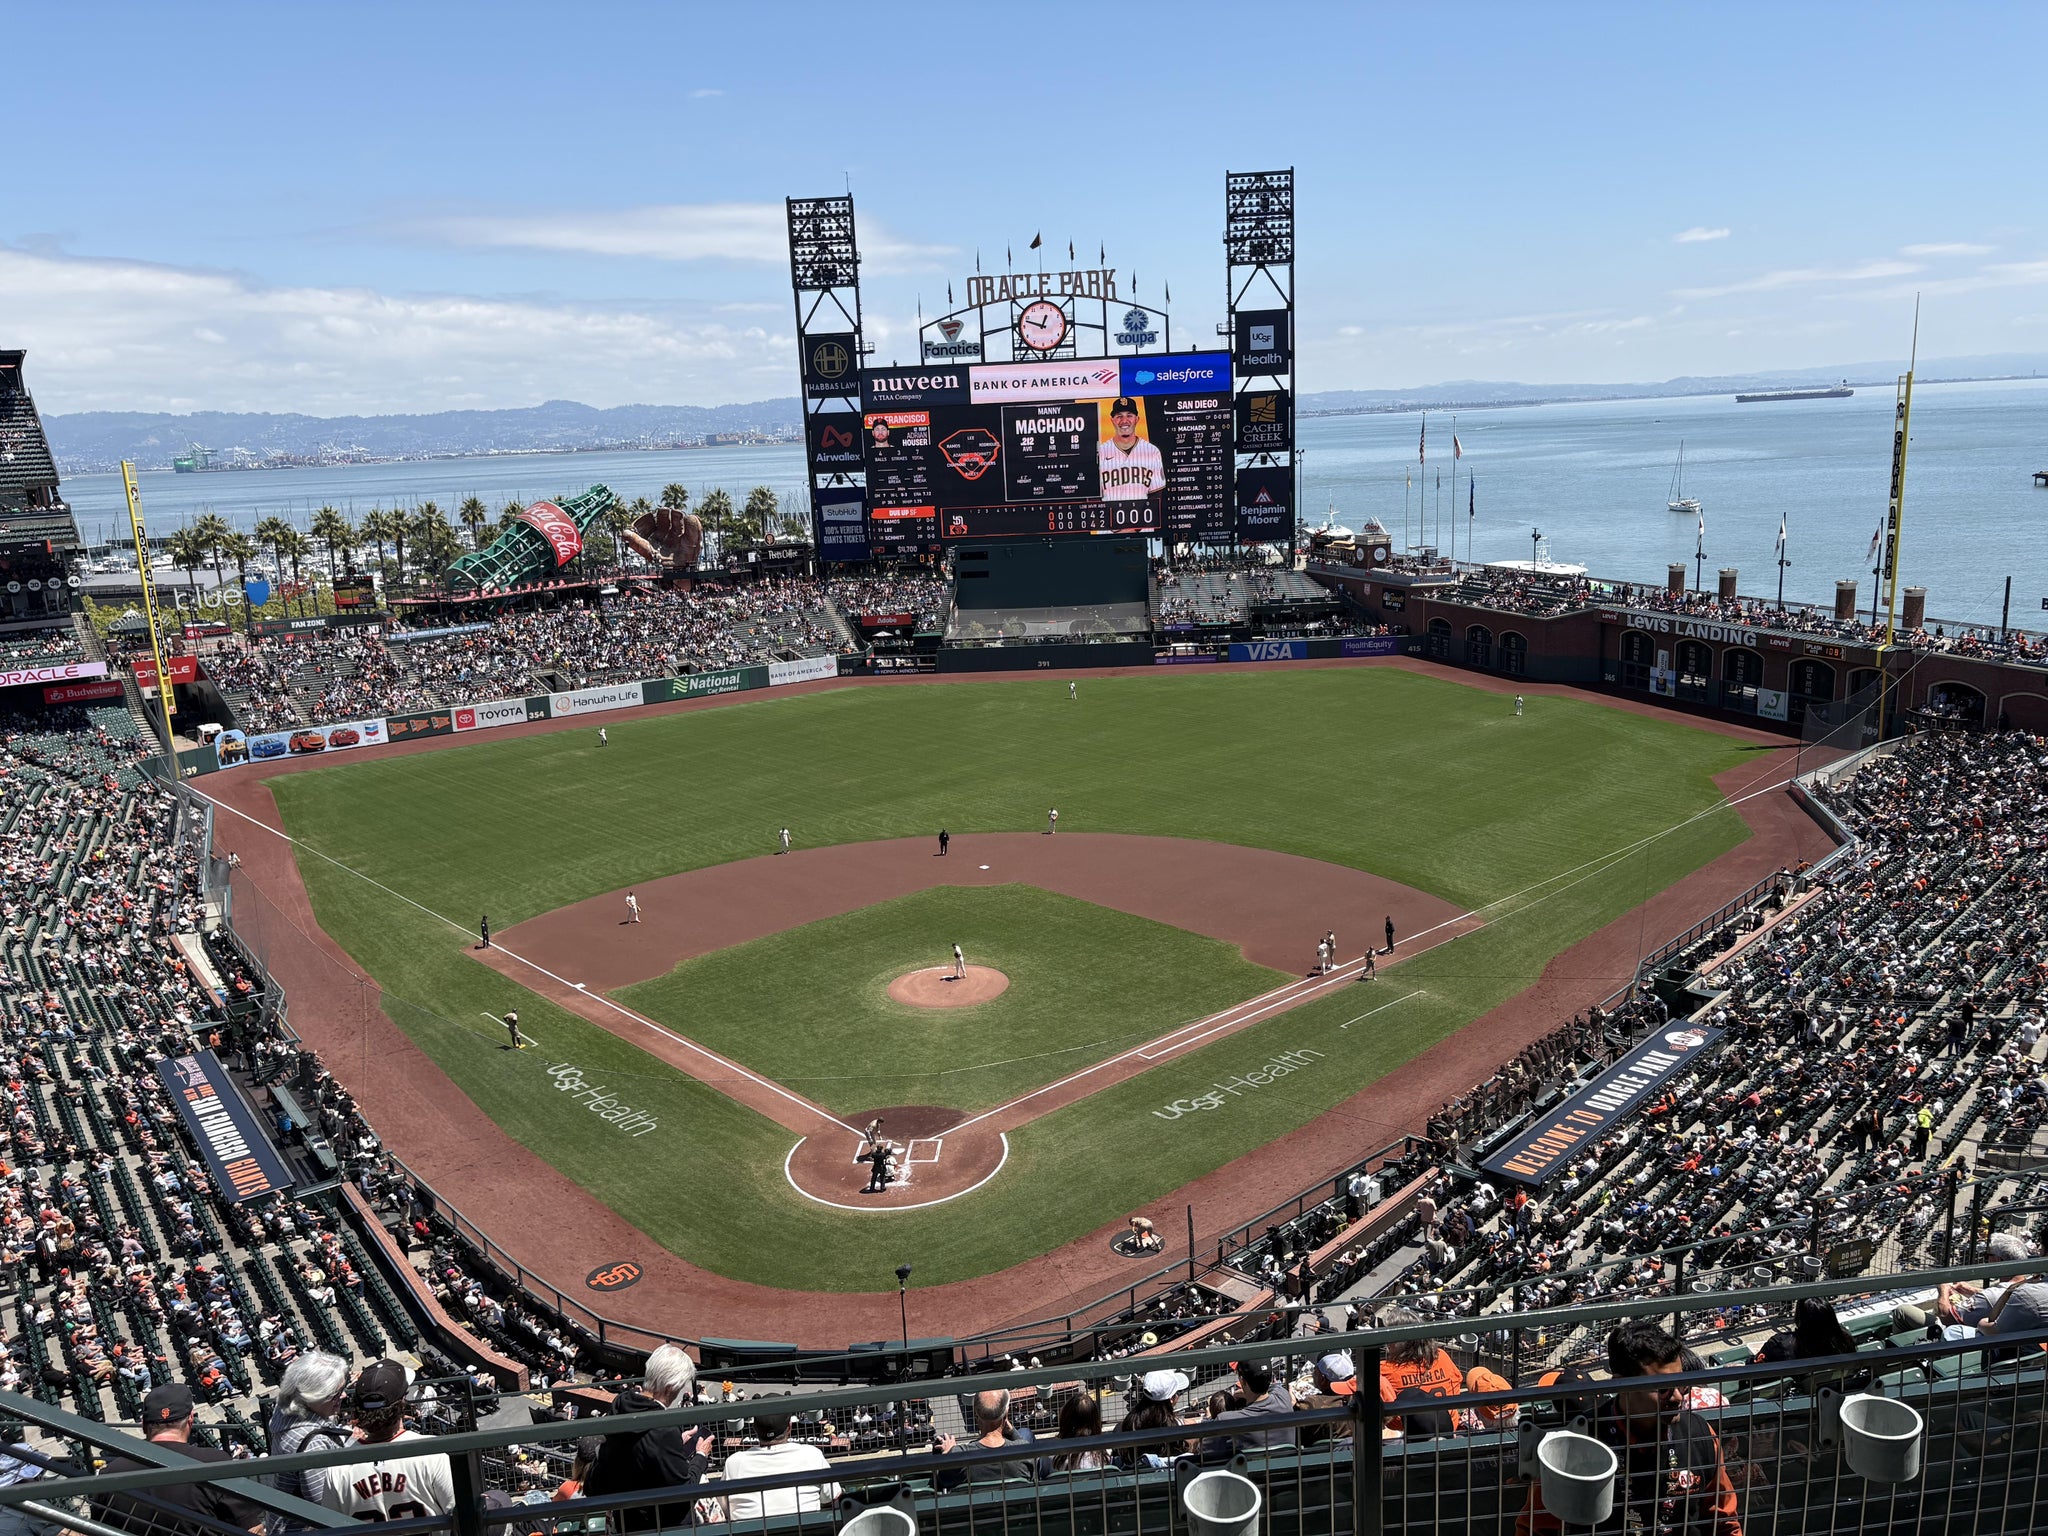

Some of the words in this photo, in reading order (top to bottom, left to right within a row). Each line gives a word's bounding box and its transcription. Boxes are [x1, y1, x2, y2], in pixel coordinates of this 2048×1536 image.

[966, 272, 1051, 308] ORACLE
[1058, 269, 1118, 301] PARK
[1118, 332, 1156, 346] coupa
[1252, 333, 1272, 342] UCSF
[924, 341, 980, 358] Fanatics
[1242, 353, 1282, 365] Health
[1157, 368, 1214, 382] salesforce
[810, 382, 840, 391] HABBAS
[872, 374, 960, 392] nuveen
[974, 380, 1008, 390] BANK
[1012, 379, 1027, 389] OF
[1031, 376, 1089, 388] AMERICA
[1038, 407, 1061, 415] MANNY
[1177, 401, 1193, 410] SAN
[1194, 399, 1218, 408] DIEGO
[888, 414, 926, 424] FRANCISCO
[1015, 416, 1085, 434] MACHADO
[1242, 423, 1283, 433] CACHE
[1049, 436, 1055, 444] 5
[1244, 432, 1282, 442] CREEK
[816, 452, 860, 462] Airwallex
[1102, 466, 1153, 490] PADRES
[1048, 512, 1054, 520] 0
[1116, 510, 1125, 524] 0
[1130, 509, 1138, 524] 0
[1144, 509, 1152, 523] 0
[1241, 505, 1285, 516] Benjamin
[825, 526, 838, 535] 100%
[839, 525, 863, 534] VERIFIED
[1049, 521, 1055, 530] 0
[1059, 522, 1064, 530] 0
[1068, 521, 1073, 529] 0
[824, 535, 843, 544] GIANTS
[844, 534, 865, 543] TICKETS
[174, 586, 242, 611] blue
[1675, 621, 1757, 647] LANDING
[1244, 643, 1293, 660] VISA
[1345, 641, 1393, 649] HealthEquity
[137, 666, 191, 679] ORCLE
[797, 667, 823, 676] AMERICA
[1604, 673, 1616, 682] 365
[689, 672, 740, 691] National
[720, 684, 739, 693] Rental
[66, 685, 117, 698] Budweiser
[573, 693, 616, 707] Hanwha
[618, 690, 638, 700] Life
[479, 706, 523, 720] TOYOTA
[529, 710, 545, 719] 354
[1862, 726, 1878, 736] 309
[1629, 1050, 1680, 1077] PARK
[1152, 1091, 1226, 1120] UCSF
[1213, 1049, 1326, 1096] Health
[546, 1062, 590, 1091] UCSF
[571, 1085, 658, 1137] Health
[1584, 1074, 1650, 1112] ORACLE
[189, 1096, 224, 1116] SAN
[1565, 1109, 1604, 1126] TO
[198, 1111, 251, 1161] FRANCISCO
[1502, 1124, 1587, 1176] WELCOME
[224, 1158, 271, 1196] GIANTS
[1850, 1250, 1860, 1258] NOT
[1434, 1368, 1446, 1380] CA
[352, 1472, 407, 1500] WEBB
